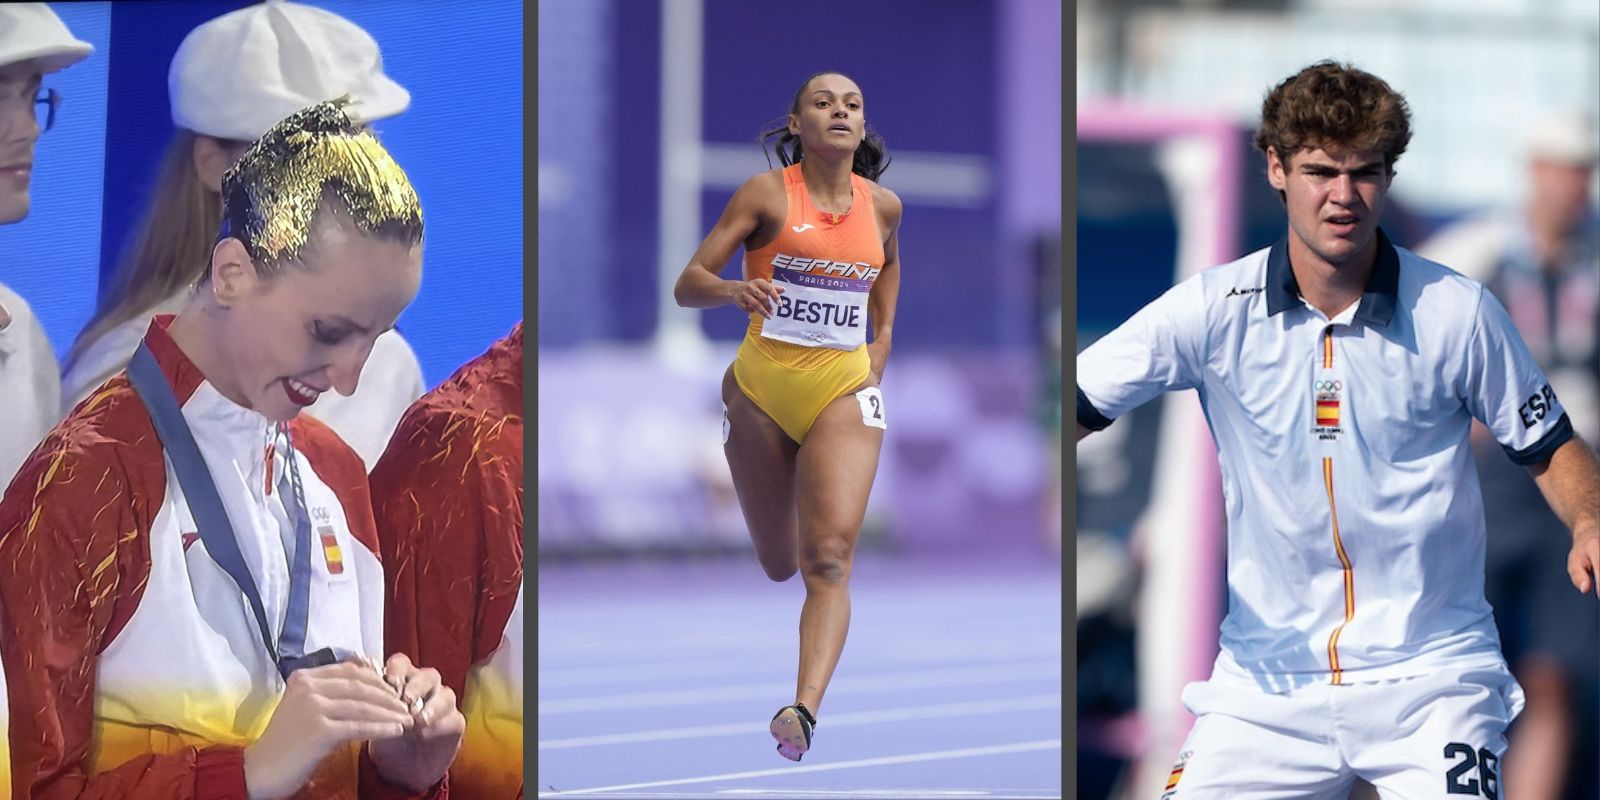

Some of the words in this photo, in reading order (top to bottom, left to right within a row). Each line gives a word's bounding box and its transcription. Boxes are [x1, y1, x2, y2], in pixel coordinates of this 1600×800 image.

[799, 275, 825, 286] PARIS
[827, 278, 849, 288] 2024
[776, 295, 860, 328] BESTUE
[868, 394, 881, 420] 2
[1443, 741, 1498, 800] 26
